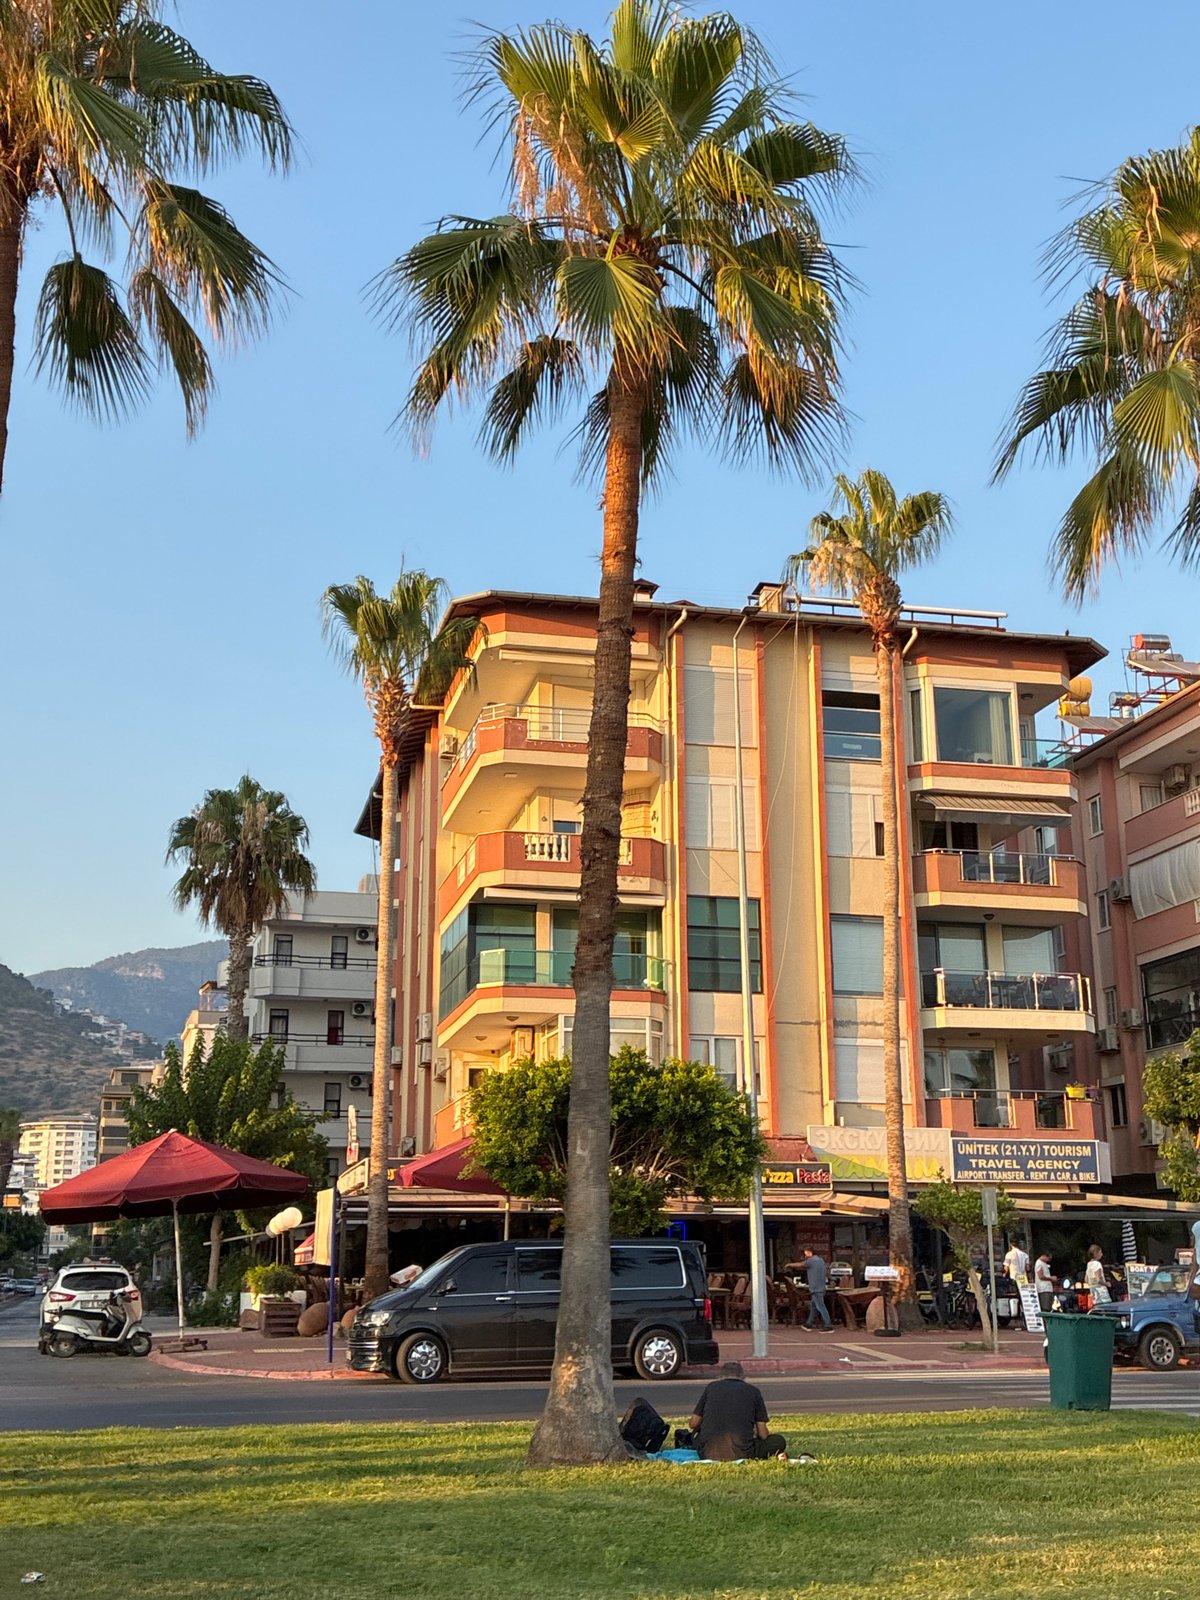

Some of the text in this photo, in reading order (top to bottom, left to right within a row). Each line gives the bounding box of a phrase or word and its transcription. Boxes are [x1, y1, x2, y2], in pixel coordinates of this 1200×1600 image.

[815, 1128, 945, 1151] ЭКСКУСИИ
[957, 1141, 1092, 1157] ÜNİTEK (21.Y.Y) TOURISM
[969, 1158, 1081, 1170] TRAVEL AGENCY
[796, 1168, 831, 1184] Pasta
[957, 1170, 987, 1180] AIRPORT
[988, 1171, 1025, 1181] TRANSFER
[1030, 1171, 1048, 1181] RENT
[1050, 1172, 1057, 1181] A
[1057, 1172, 1071, 1181] CAR
[1079, 1172, 1096, 1181] BIKE
